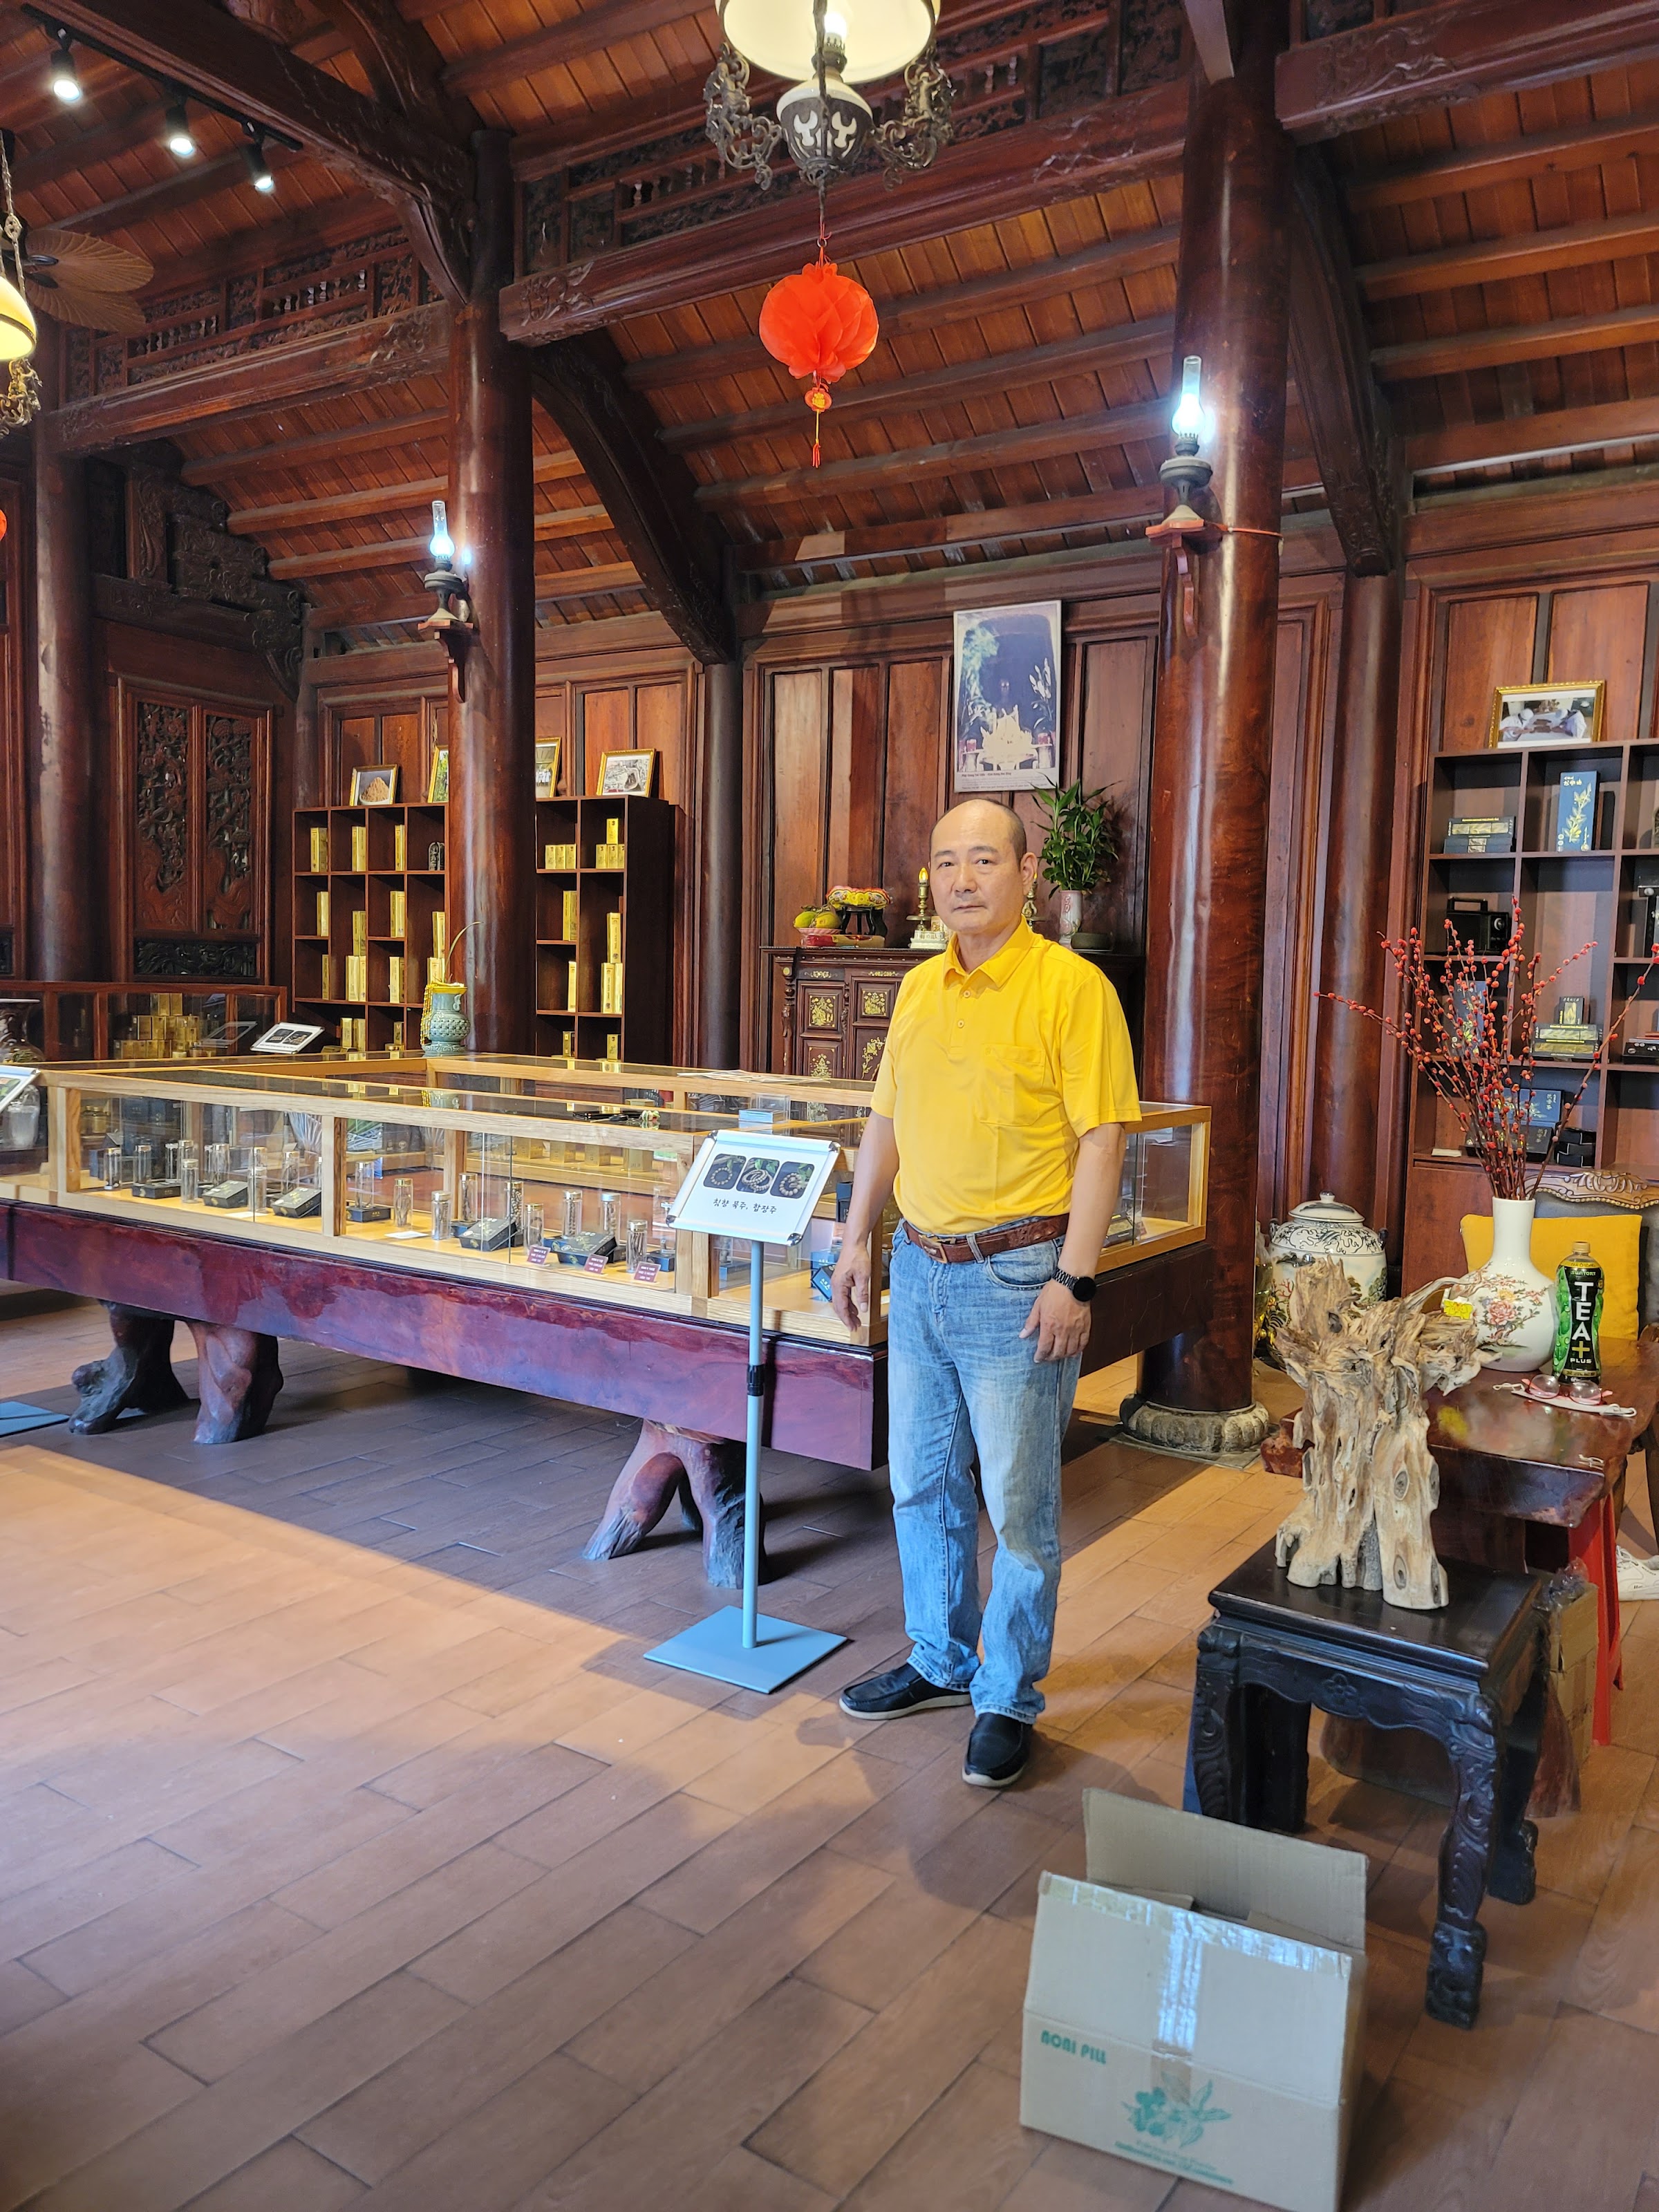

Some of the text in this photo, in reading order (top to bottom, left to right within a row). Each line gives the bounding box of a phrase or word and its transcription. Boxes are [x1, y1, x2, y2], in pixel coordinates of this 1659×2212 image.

[713, 1198, 729, 1208] 침향
[753, 1203, 777, 1214] 합장주
[1080, 2044, 1106, 2065] PILL
